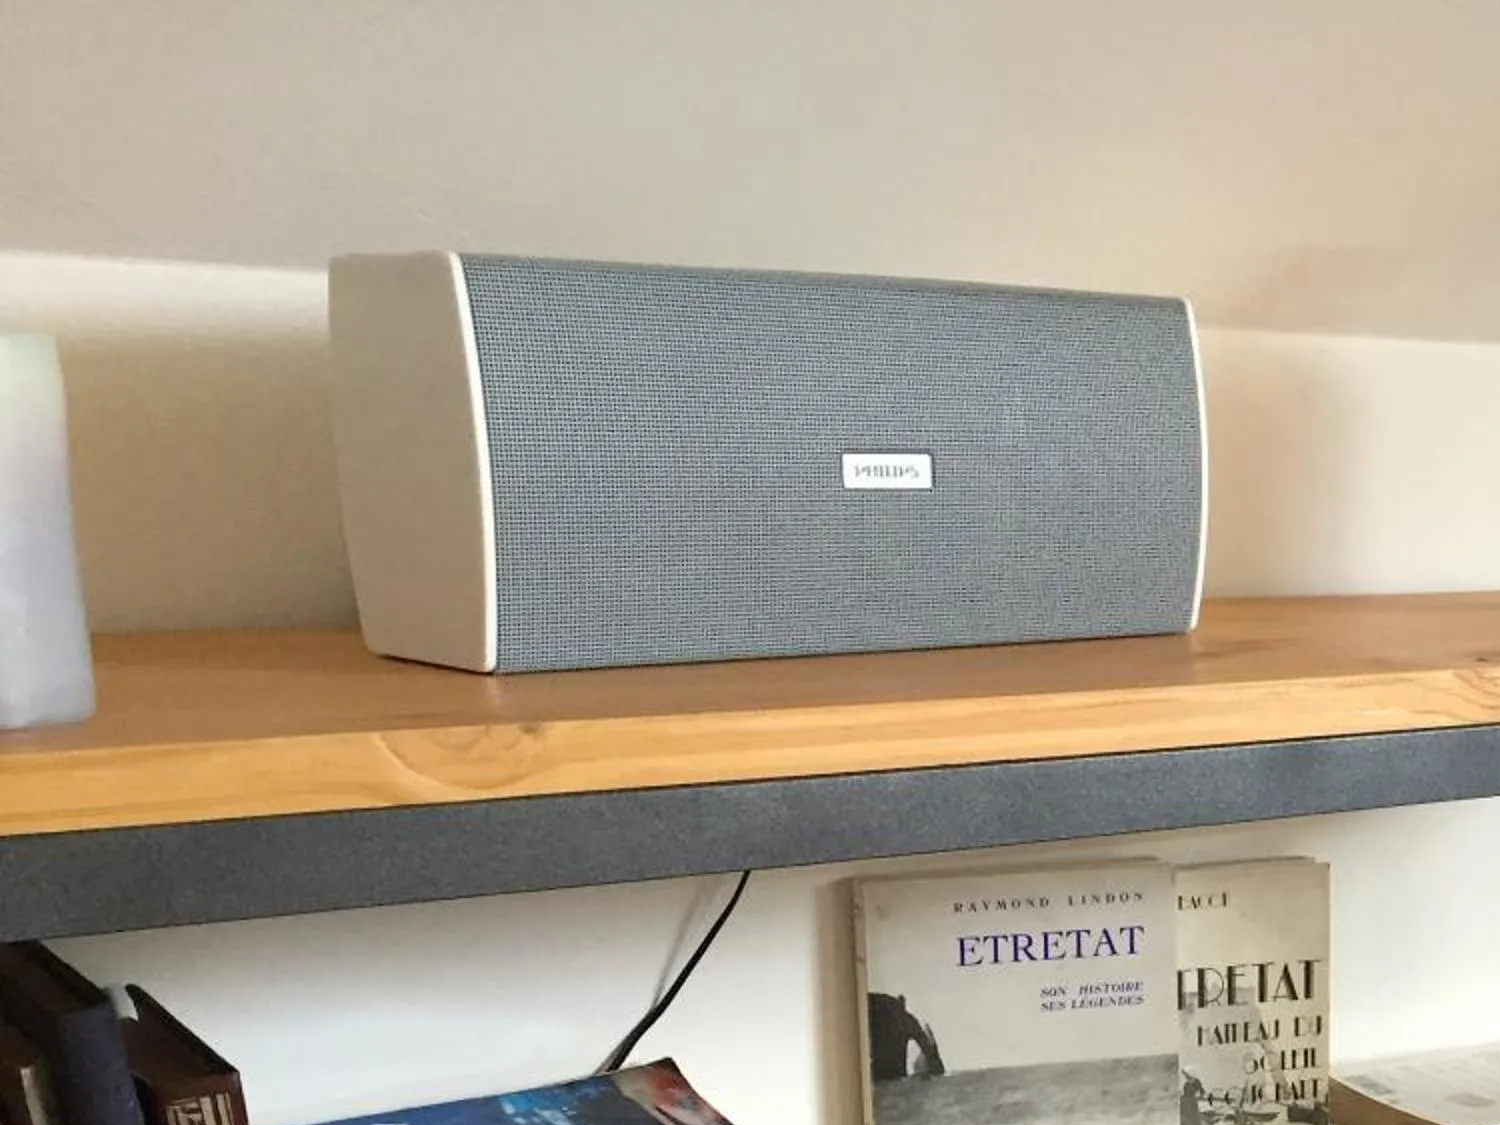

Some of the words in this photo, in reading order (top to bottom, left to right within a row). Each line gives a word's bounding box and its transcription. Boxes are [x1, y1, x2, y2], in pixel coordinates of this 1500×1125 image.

[953, 897, 1049, 913] RAYMOND
[957, 925, 1145, 966] ETRETAT
[1040, 987, 1067, 1000] SON
[1079, 981, 1145, 996] HISTOIRE
[1041, 1001, 1065, 1013] SES
